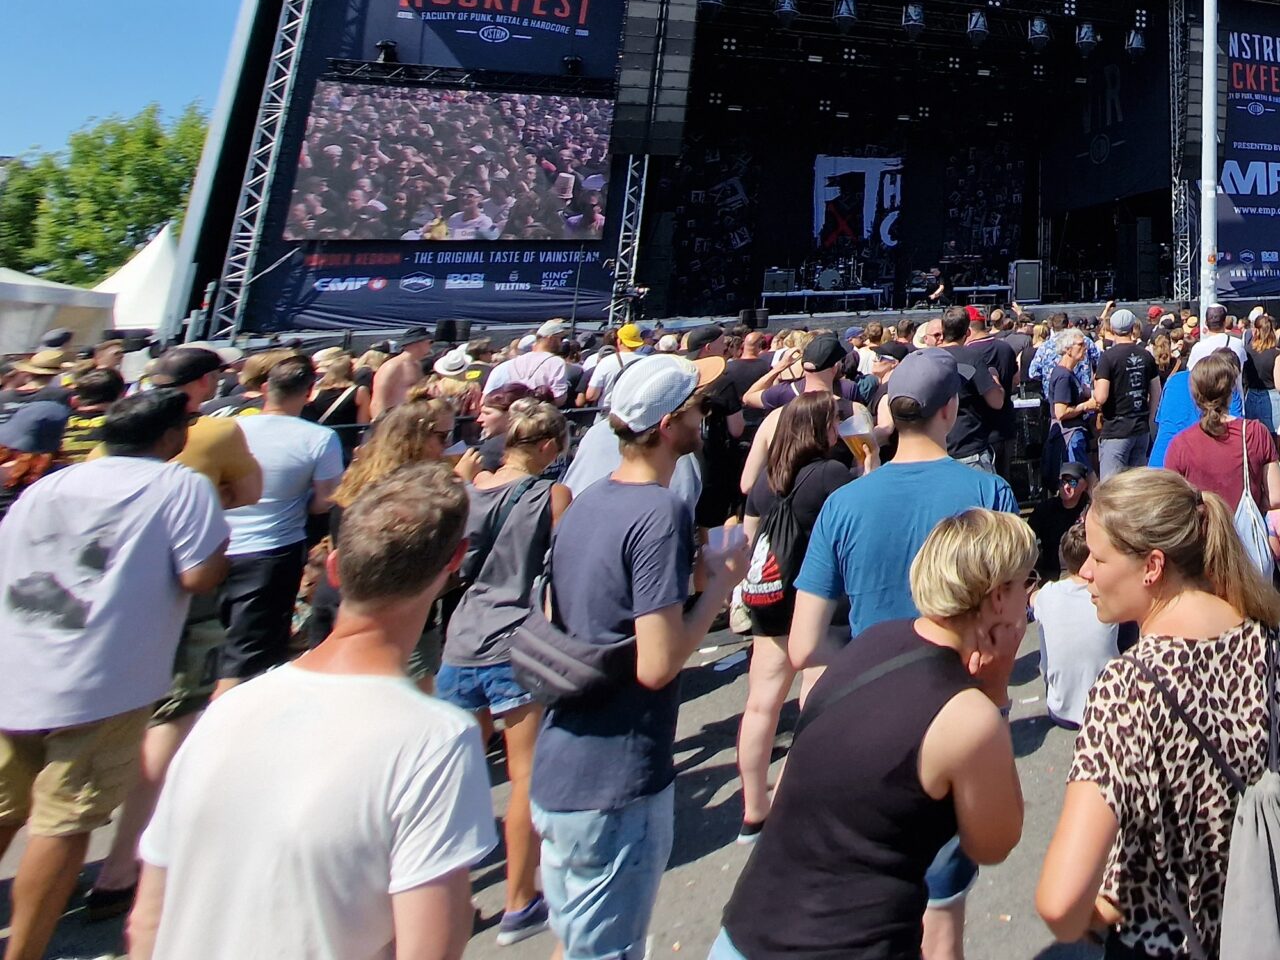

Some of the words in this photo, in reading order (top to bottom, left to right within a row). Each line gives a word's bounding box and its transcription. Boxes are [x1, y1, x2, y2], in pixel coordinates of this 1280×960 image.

[421, 11, 456, 21] FACULTY
[457, 13, 468, 21] OF
[469, 13, 494, 23] PUNK,
[496, 14, 521, 26] METAL
[522, 17, 529, 27] &
[530, 19, 571, 35] HARDCORE
[1233, 141, 1273, 151] PRESENTED
[414, 251, 435, 264] THE
[436, 251, 485, 264] ORIGINAL
[489, 251, 520, 264] TASTE
[523, 251, 537, 263] OF
[539, 251, 600, 263] VAINSTREAM
[542, 271, 568, 279] KING
[494, 282, 531, 291] VELTINS
[540, 279, 567, 287] STAR
